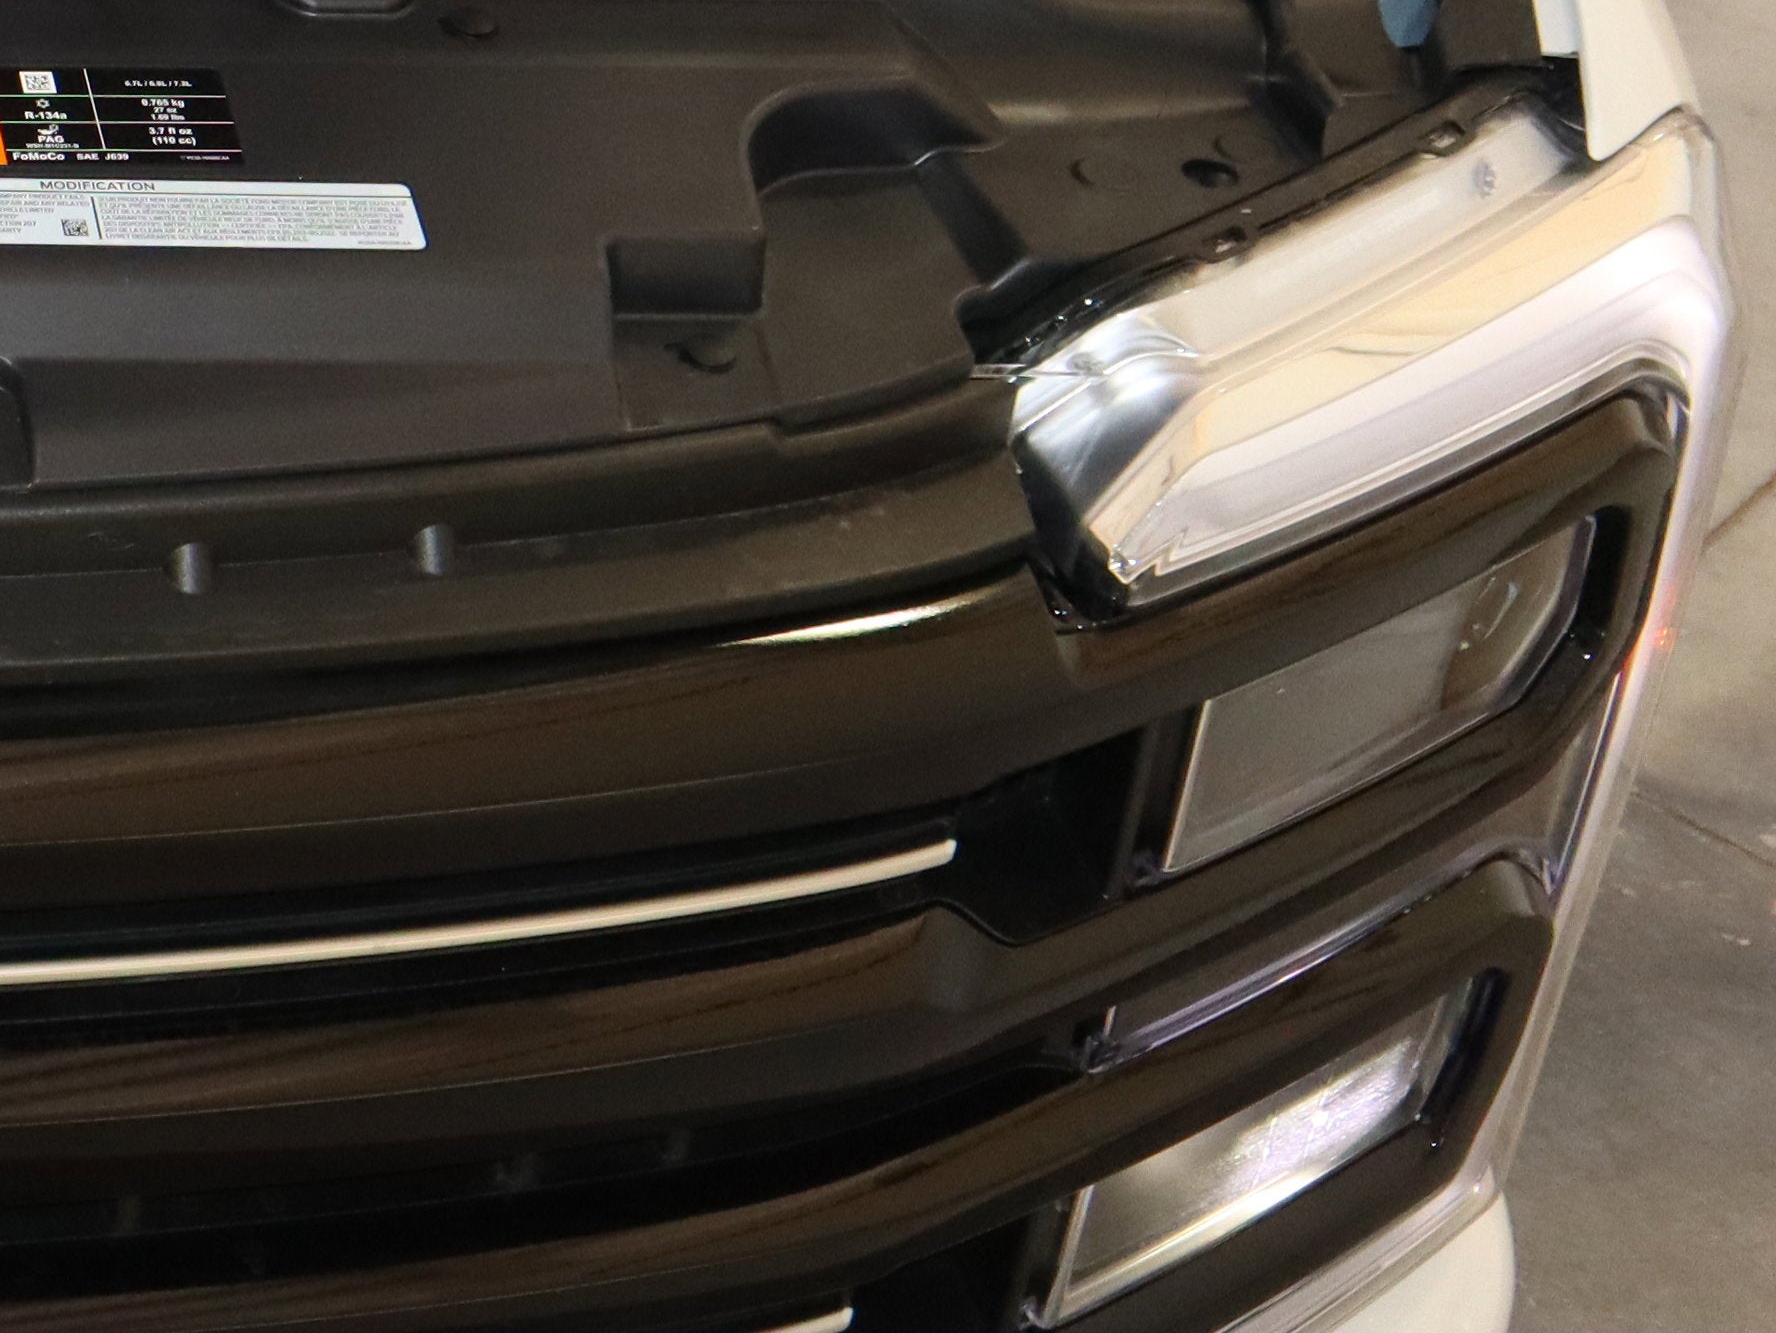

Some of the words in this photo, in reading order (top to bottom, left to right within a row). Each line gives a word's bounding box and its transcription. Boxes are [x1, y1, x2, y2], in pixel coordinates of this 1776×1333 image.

[24, 111, 68, 120] R-134a
[37, 135, 65, 144] PAG
[12, 151, 66, 161] FoMoCo
[76, 152, 100, 161] SAE
[104, 152, 130, 161] J639
[39, 180, 156, 192] MODIFICATION
